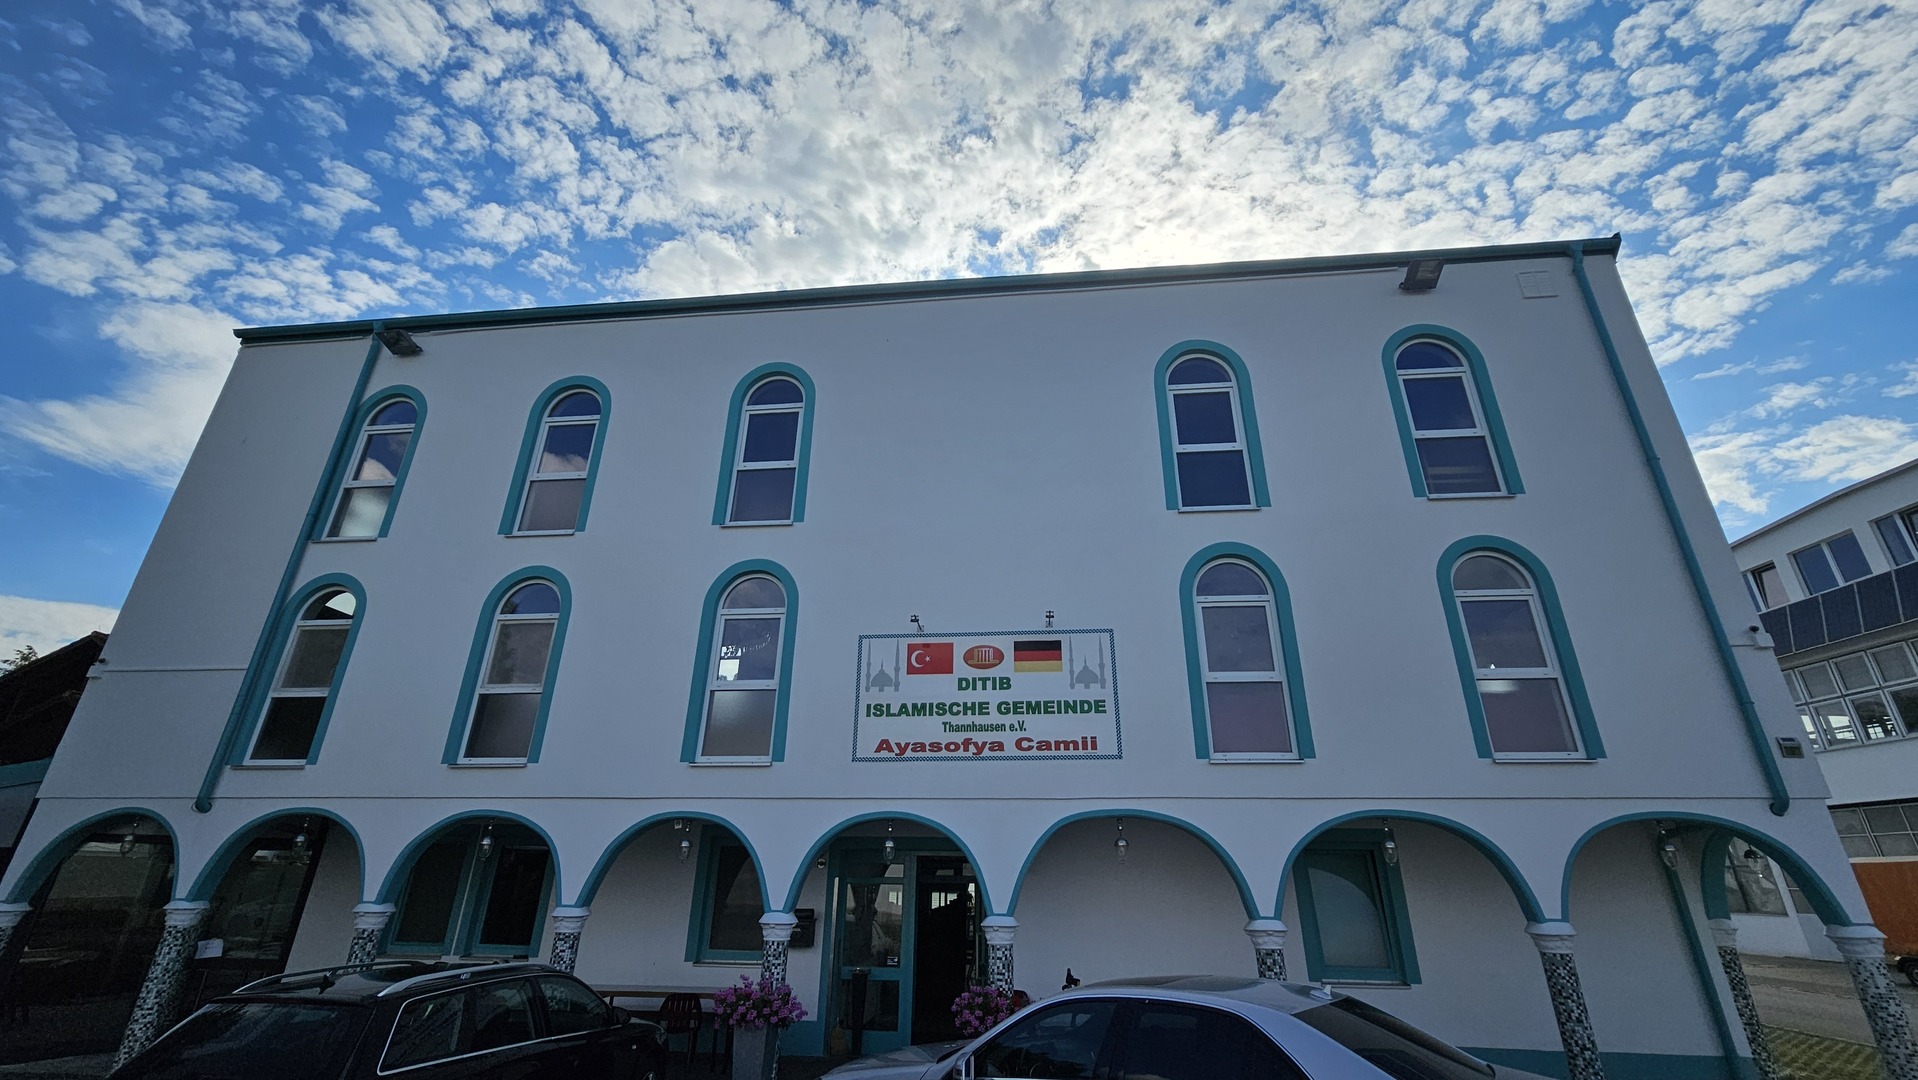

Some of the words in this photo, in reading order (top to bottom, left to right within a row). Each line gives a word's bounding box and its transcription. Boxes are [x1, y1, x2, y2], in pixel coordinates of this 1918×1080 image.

[957, 676, 1012, 691] DITIB
[865, 701, 990, 717] ISLAMISCHE
[997, 699, 1107, 715] GEMEINDE
[942, 720, 1006, 733] Thannhausen
[1009, 720, 1027, 732] e.V.
[874, 737, 1005, 756] Ayasofya
[1015, 736, 1098, 752] Camii
